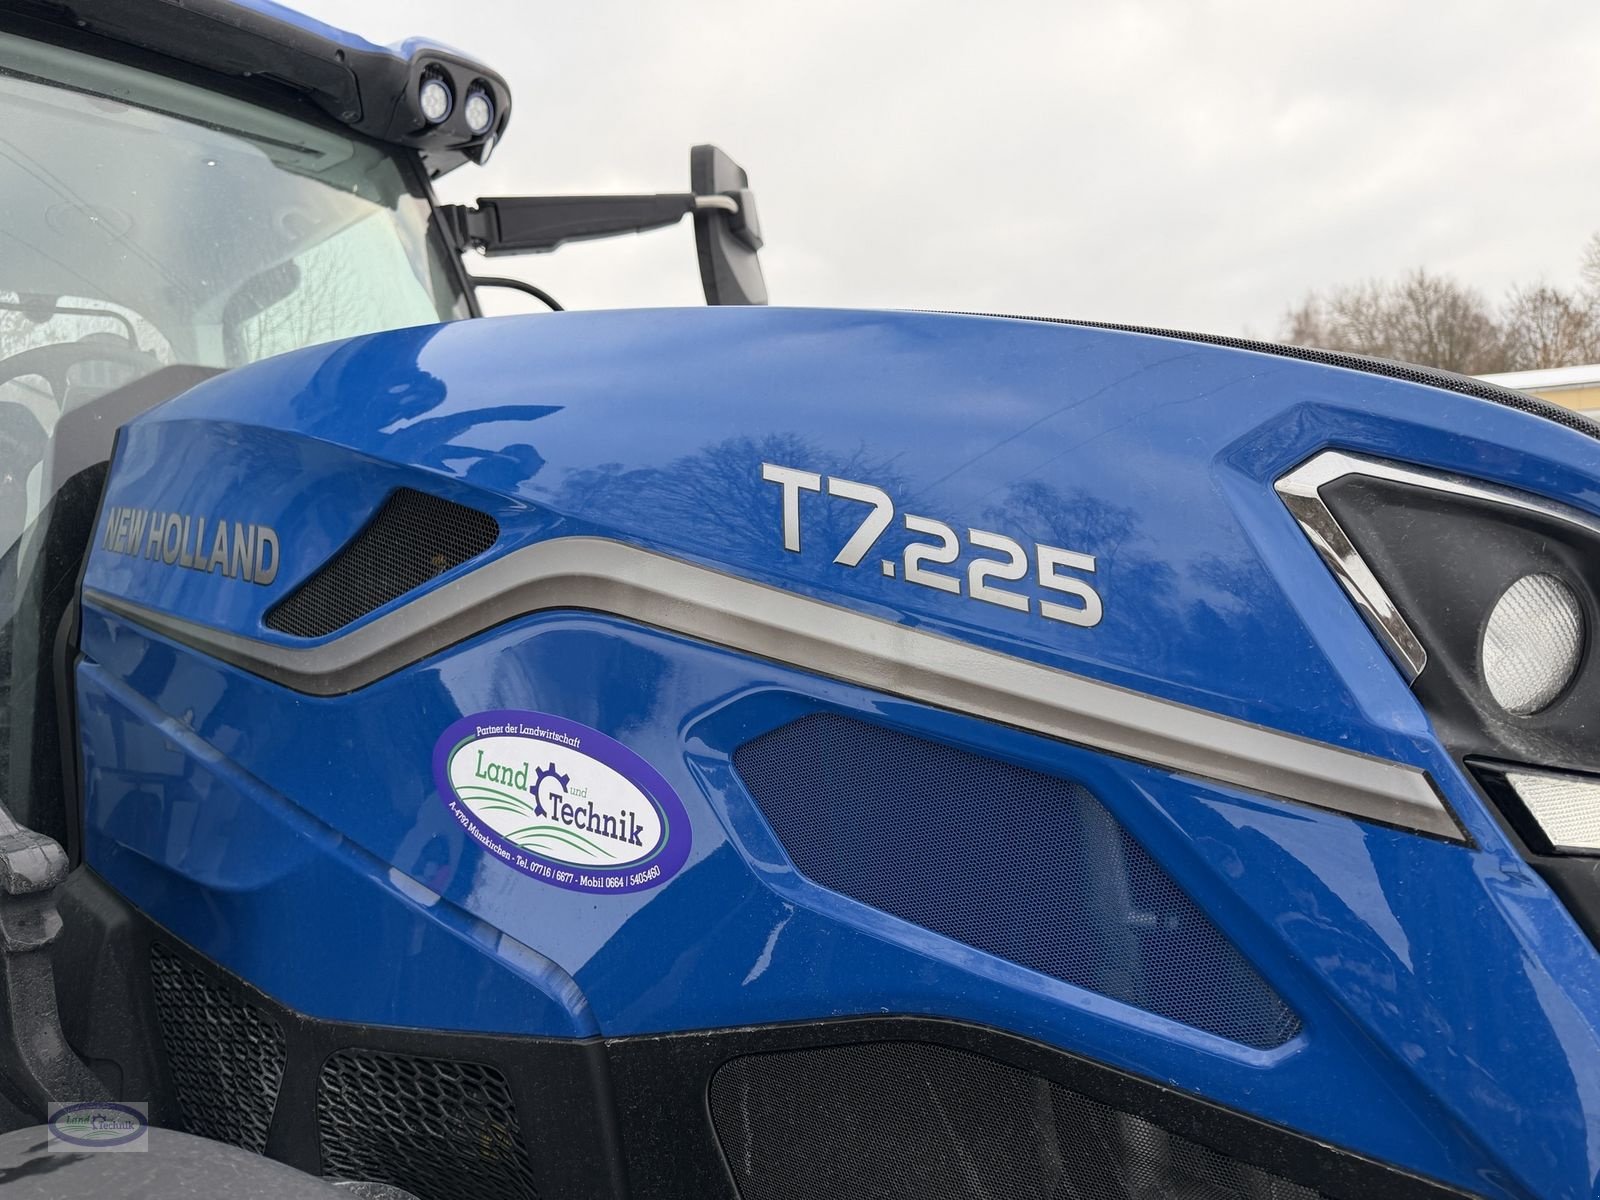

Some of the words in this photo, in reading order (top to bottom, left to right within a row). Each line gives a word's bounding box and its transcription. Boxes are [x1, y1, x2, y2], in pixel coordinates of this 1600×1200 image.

[103, 507, 148, 557] NEW
[144, 511, 280, 586] HOLLAND
[761, 462, 1103, 628] T7.225
[476, 725, 504, 736] Partner
[505, 723, 518, 733] der
[519, 723, 581, 748] Landwirtschaft
[475, 750, 529, 791] Land
[569, 786, 588, 799] und
[448, 801, 469, 827] A-4792
[467, 822, 511, 860] Münzkirchen
[515, 854, 529, 870] Tel.
[529, 861, 552, 877] 07716
[556, 870, 574, 883] 6677
[579, 875, 604, 888] Mobil
[605, 876, 624, 888] 0664
[629, 865, 661, 886] 5405460
[549, 792, 644, 847] Technik
